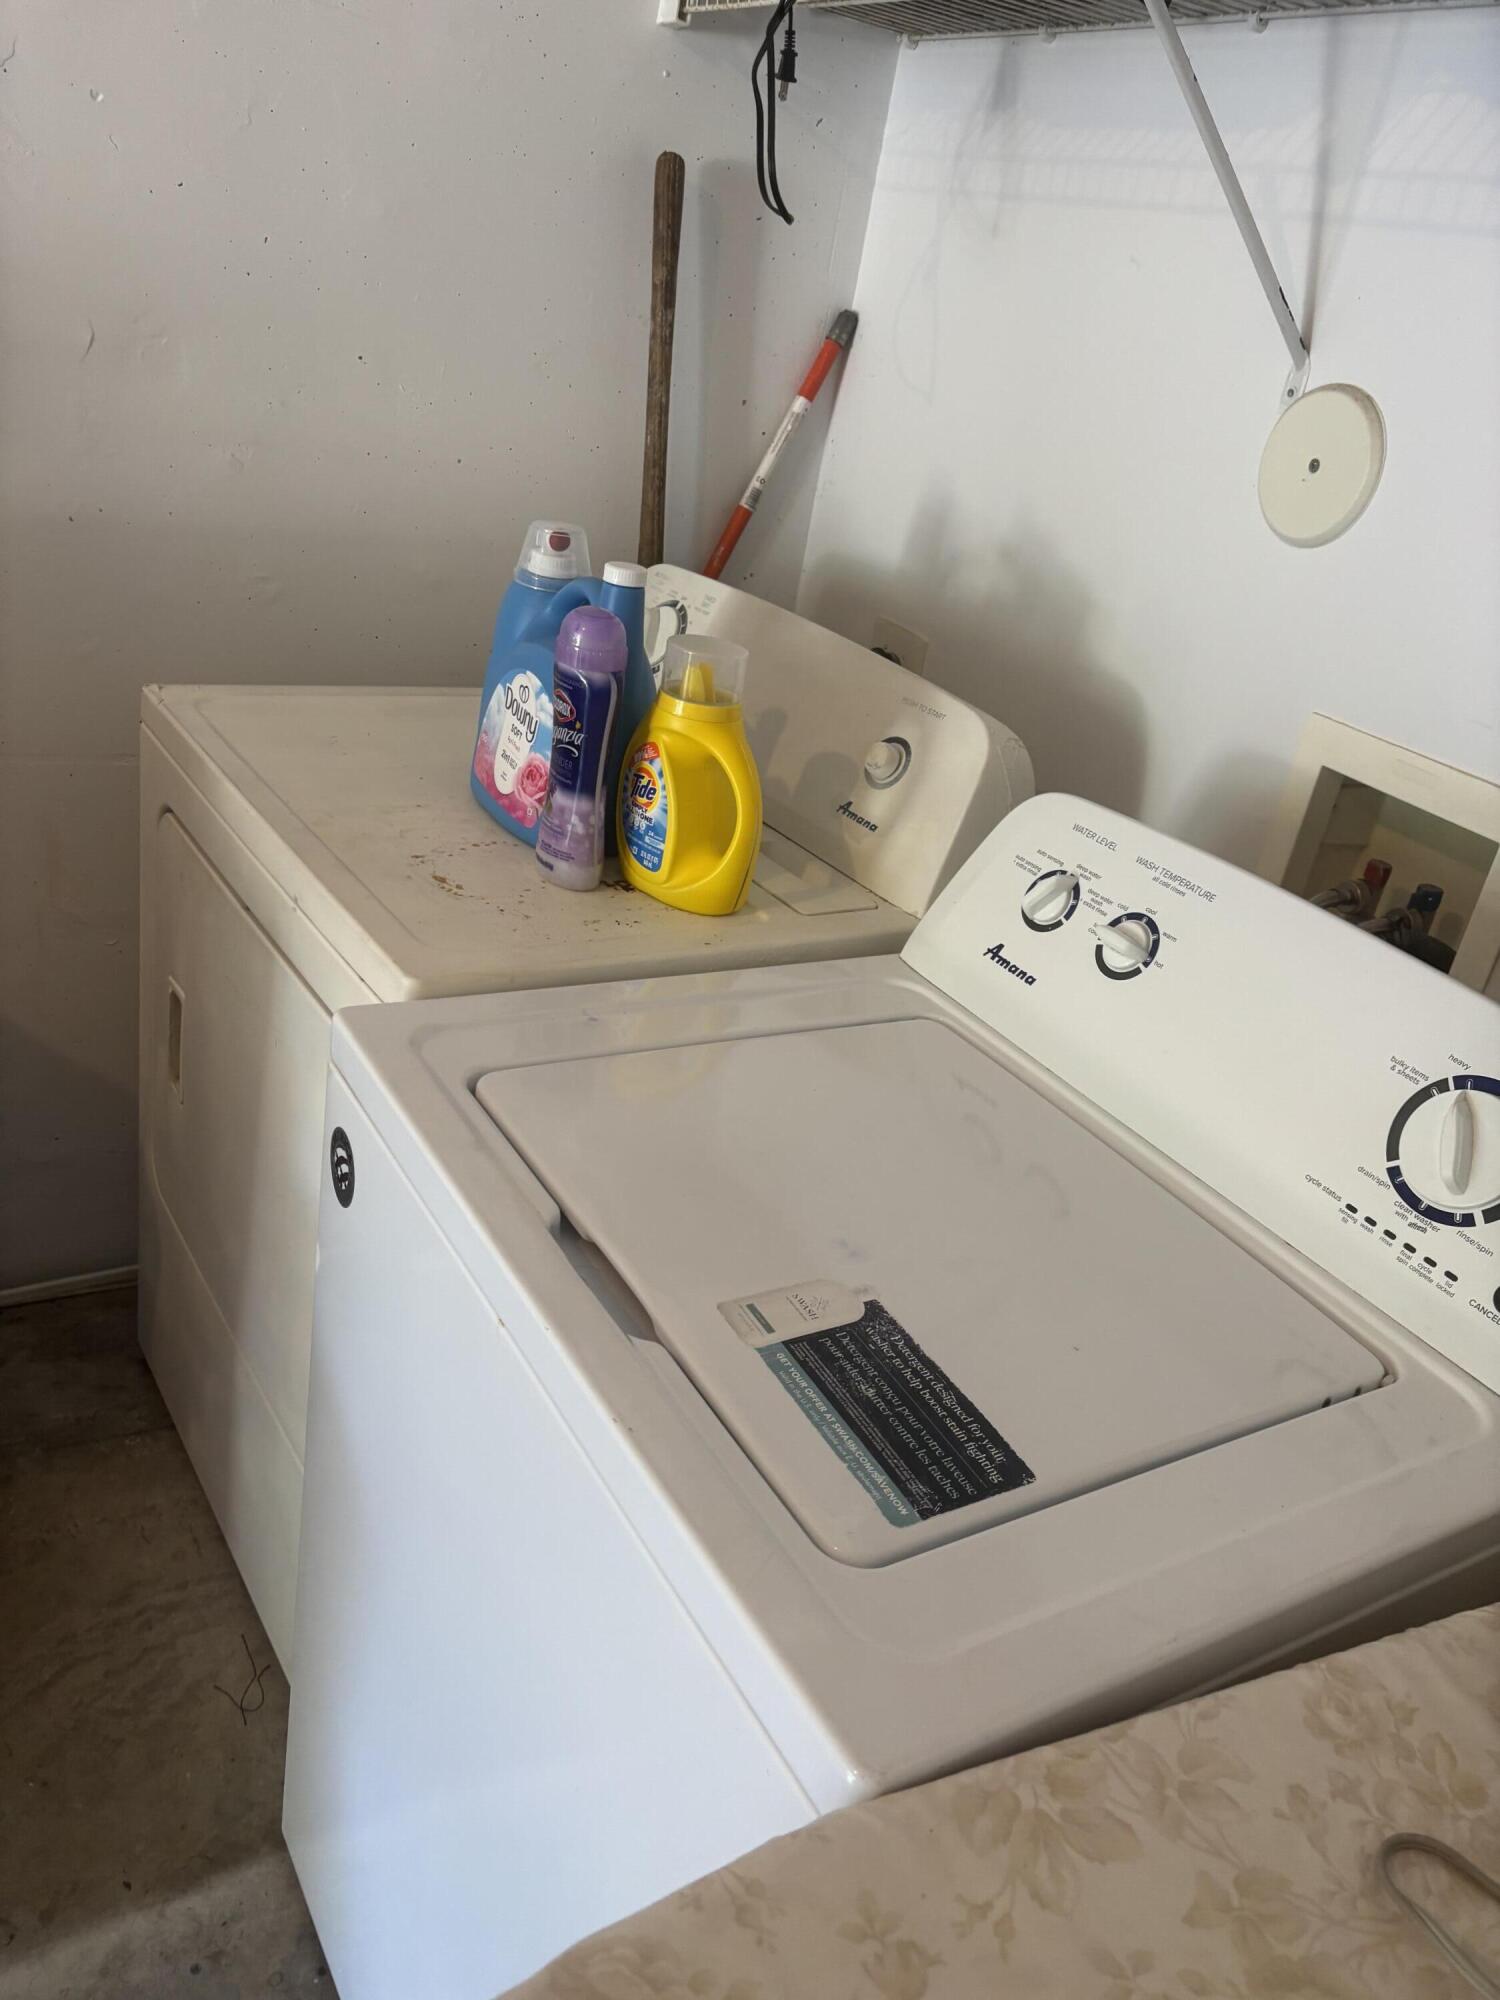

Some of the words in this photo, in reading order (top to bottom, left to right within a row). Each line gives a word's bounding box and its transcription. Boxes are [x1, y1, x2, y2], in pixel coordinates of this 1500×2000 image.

[505, 686, 538, 743] Downy
[927, 707, 946, 721] START
[630, 773, 657, 801] Tide
[836, 801, 879, 832] Amana
[1072, 823, 1098, 840] WATER
[1096, 836, 1118, 852] LEVEL
[1136, 856, 1160, 873] WASH
[1160, 867, 1217, 903] TEMPERATURE
[1158, 879, 1172, 890] cold
[1170, 885, 1186, 898] rinses
[1088, 888, 1100, 898] deep
[1100, 895, 1114, 905] water
[1117, 902, 1130, 912] cold
[1145, 907, 1158, 916] cool
[1162, 932, 1178, 943] warm
[982, 943, 1037, 986] Amana
[1154, 960, 1164, 970] hot
[1390, 1056, 1410, 1072] bulky
[1409, 1066, 1430, 1082] items
[1448, 1054, 1472, 1071] heavy
[1396, 1069, 1421, 1086] sheets
[1304, 1174, 1322, 1188] cycle
[1322, 1186, 1342, 1202] status
[1357, 1166, 1391, 1190] drain/spin
[1394, 1210, 1409, 1222] with
[1394, 1200, 1414, 1216] clean
[1414, 1214, 1440, 1233] washer
[1456, 1230, 1494, 1258] rinse/spin
[1396, 1256, 1408, 1266] spin
[1400, 1250, 1413, 1261] final
[1408, 1264, 1434, 1284] complete
[1417, 1262, 1432, 1275] cycle
[1436, 1282, 1456, 1298] locked
[1444, 1280, 1454, 1289] lid
[776, 1352, 792, 1366] GET
[789, 1367, 808, 1388] YOUR
[804, 1388, 828, 1412] OFFER
[824, 1412, 836, 1423] AT
[890, 1334, 934, 1380] Detergent
[930, 1381, 974, 1423] designed
[968, 1422, 986, 1440] for
[982, 1438, 1004, 1462] your
[866, 1327, 896, 1358] washer
[892, 1358, 904, 1368] to
[902, 1368, 922, 1390] help
[920, 1389, 948, 1417] boost
[944, 1416, 968, 1442] stain
[964, 1442, 1002, 1483] fighting
[819, 1338, 844, 1358] pour
[889, 1416, 920, 1450] contre
[916, 1448, 930, 1465] les
[928, 1465, 960, 1500] taches
[896, 1405, 924, 1434] pour
[919, 1430, 945, 1456] votre
[942, 1456, 977, 1496] laveuse
